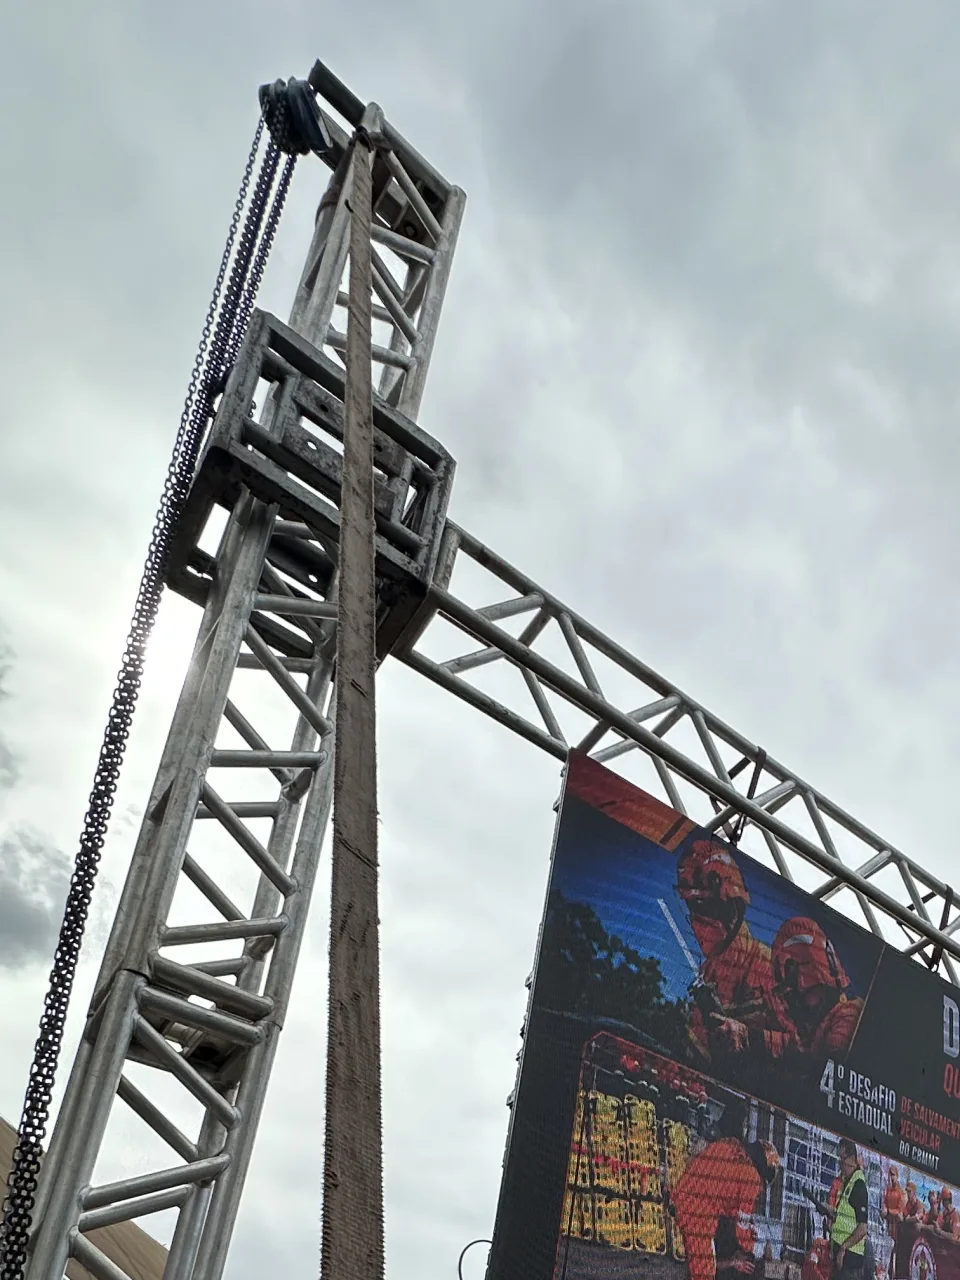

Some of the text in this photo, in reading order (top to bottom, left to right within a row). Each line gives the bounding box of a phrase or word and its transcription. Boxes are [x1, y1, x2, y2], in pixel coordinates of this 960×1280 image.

[819, 1058, 896, 1112] 4º DESAFIO
[838, 1091, 893, 1136] ESTADUAL
[901, 1096, 911, 1116] DE
[900, 1119, 941, 1152] VEICULAR
[899, 1140, 940, 1170] DO CBMMT
